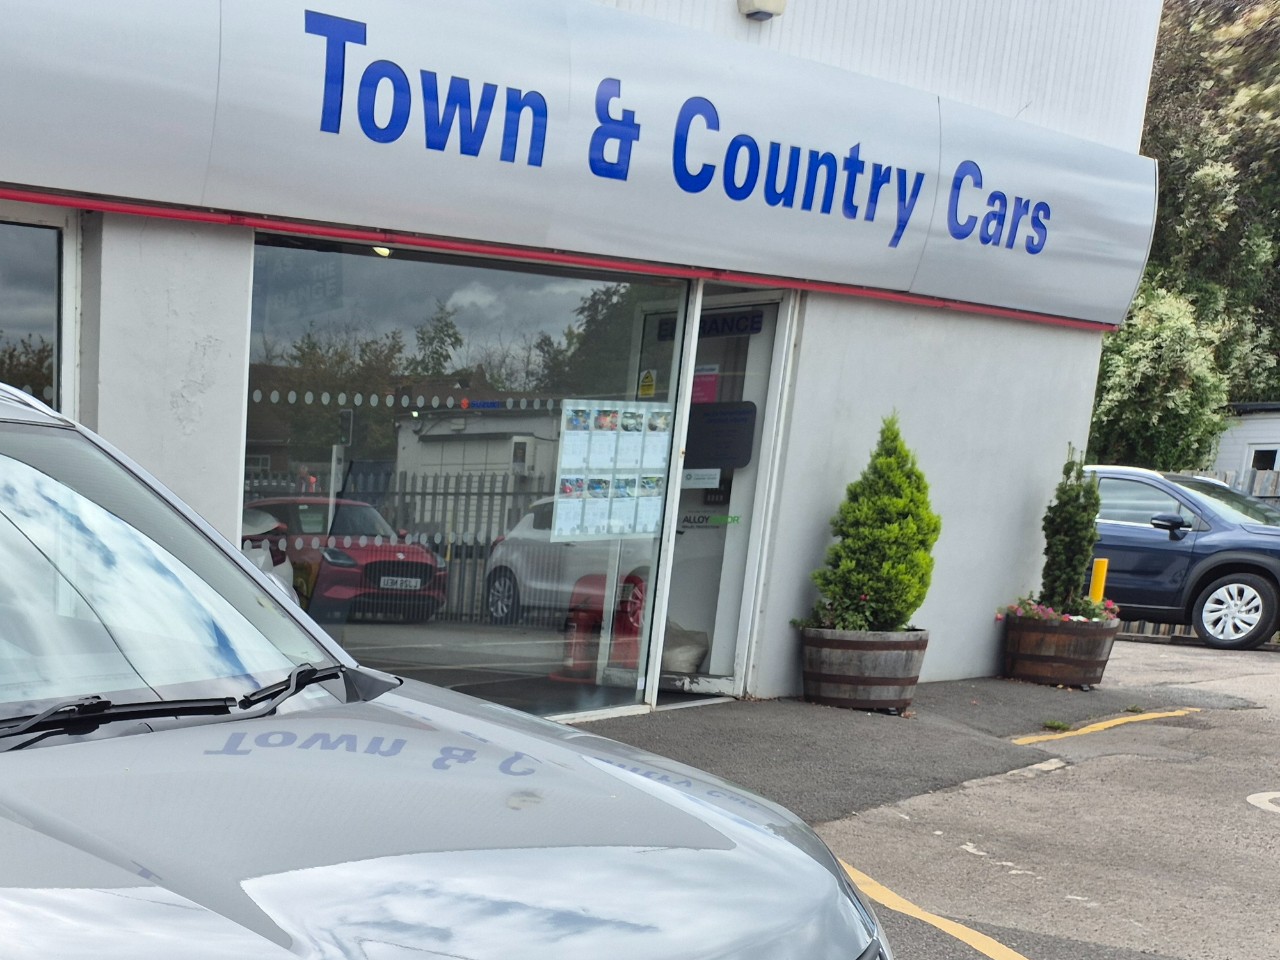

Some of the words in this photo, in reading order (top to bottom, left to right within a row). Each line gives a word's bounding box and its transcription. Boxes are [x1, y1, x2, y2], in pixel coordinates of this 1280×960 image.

[304, 9, 549, 168] Town
[588, 77, 642, 182] &
[672, 96, 925, 249] Country
[946, 159, 1052, 256] Cars
[682, 515, 740, 525] ALLOYOR
